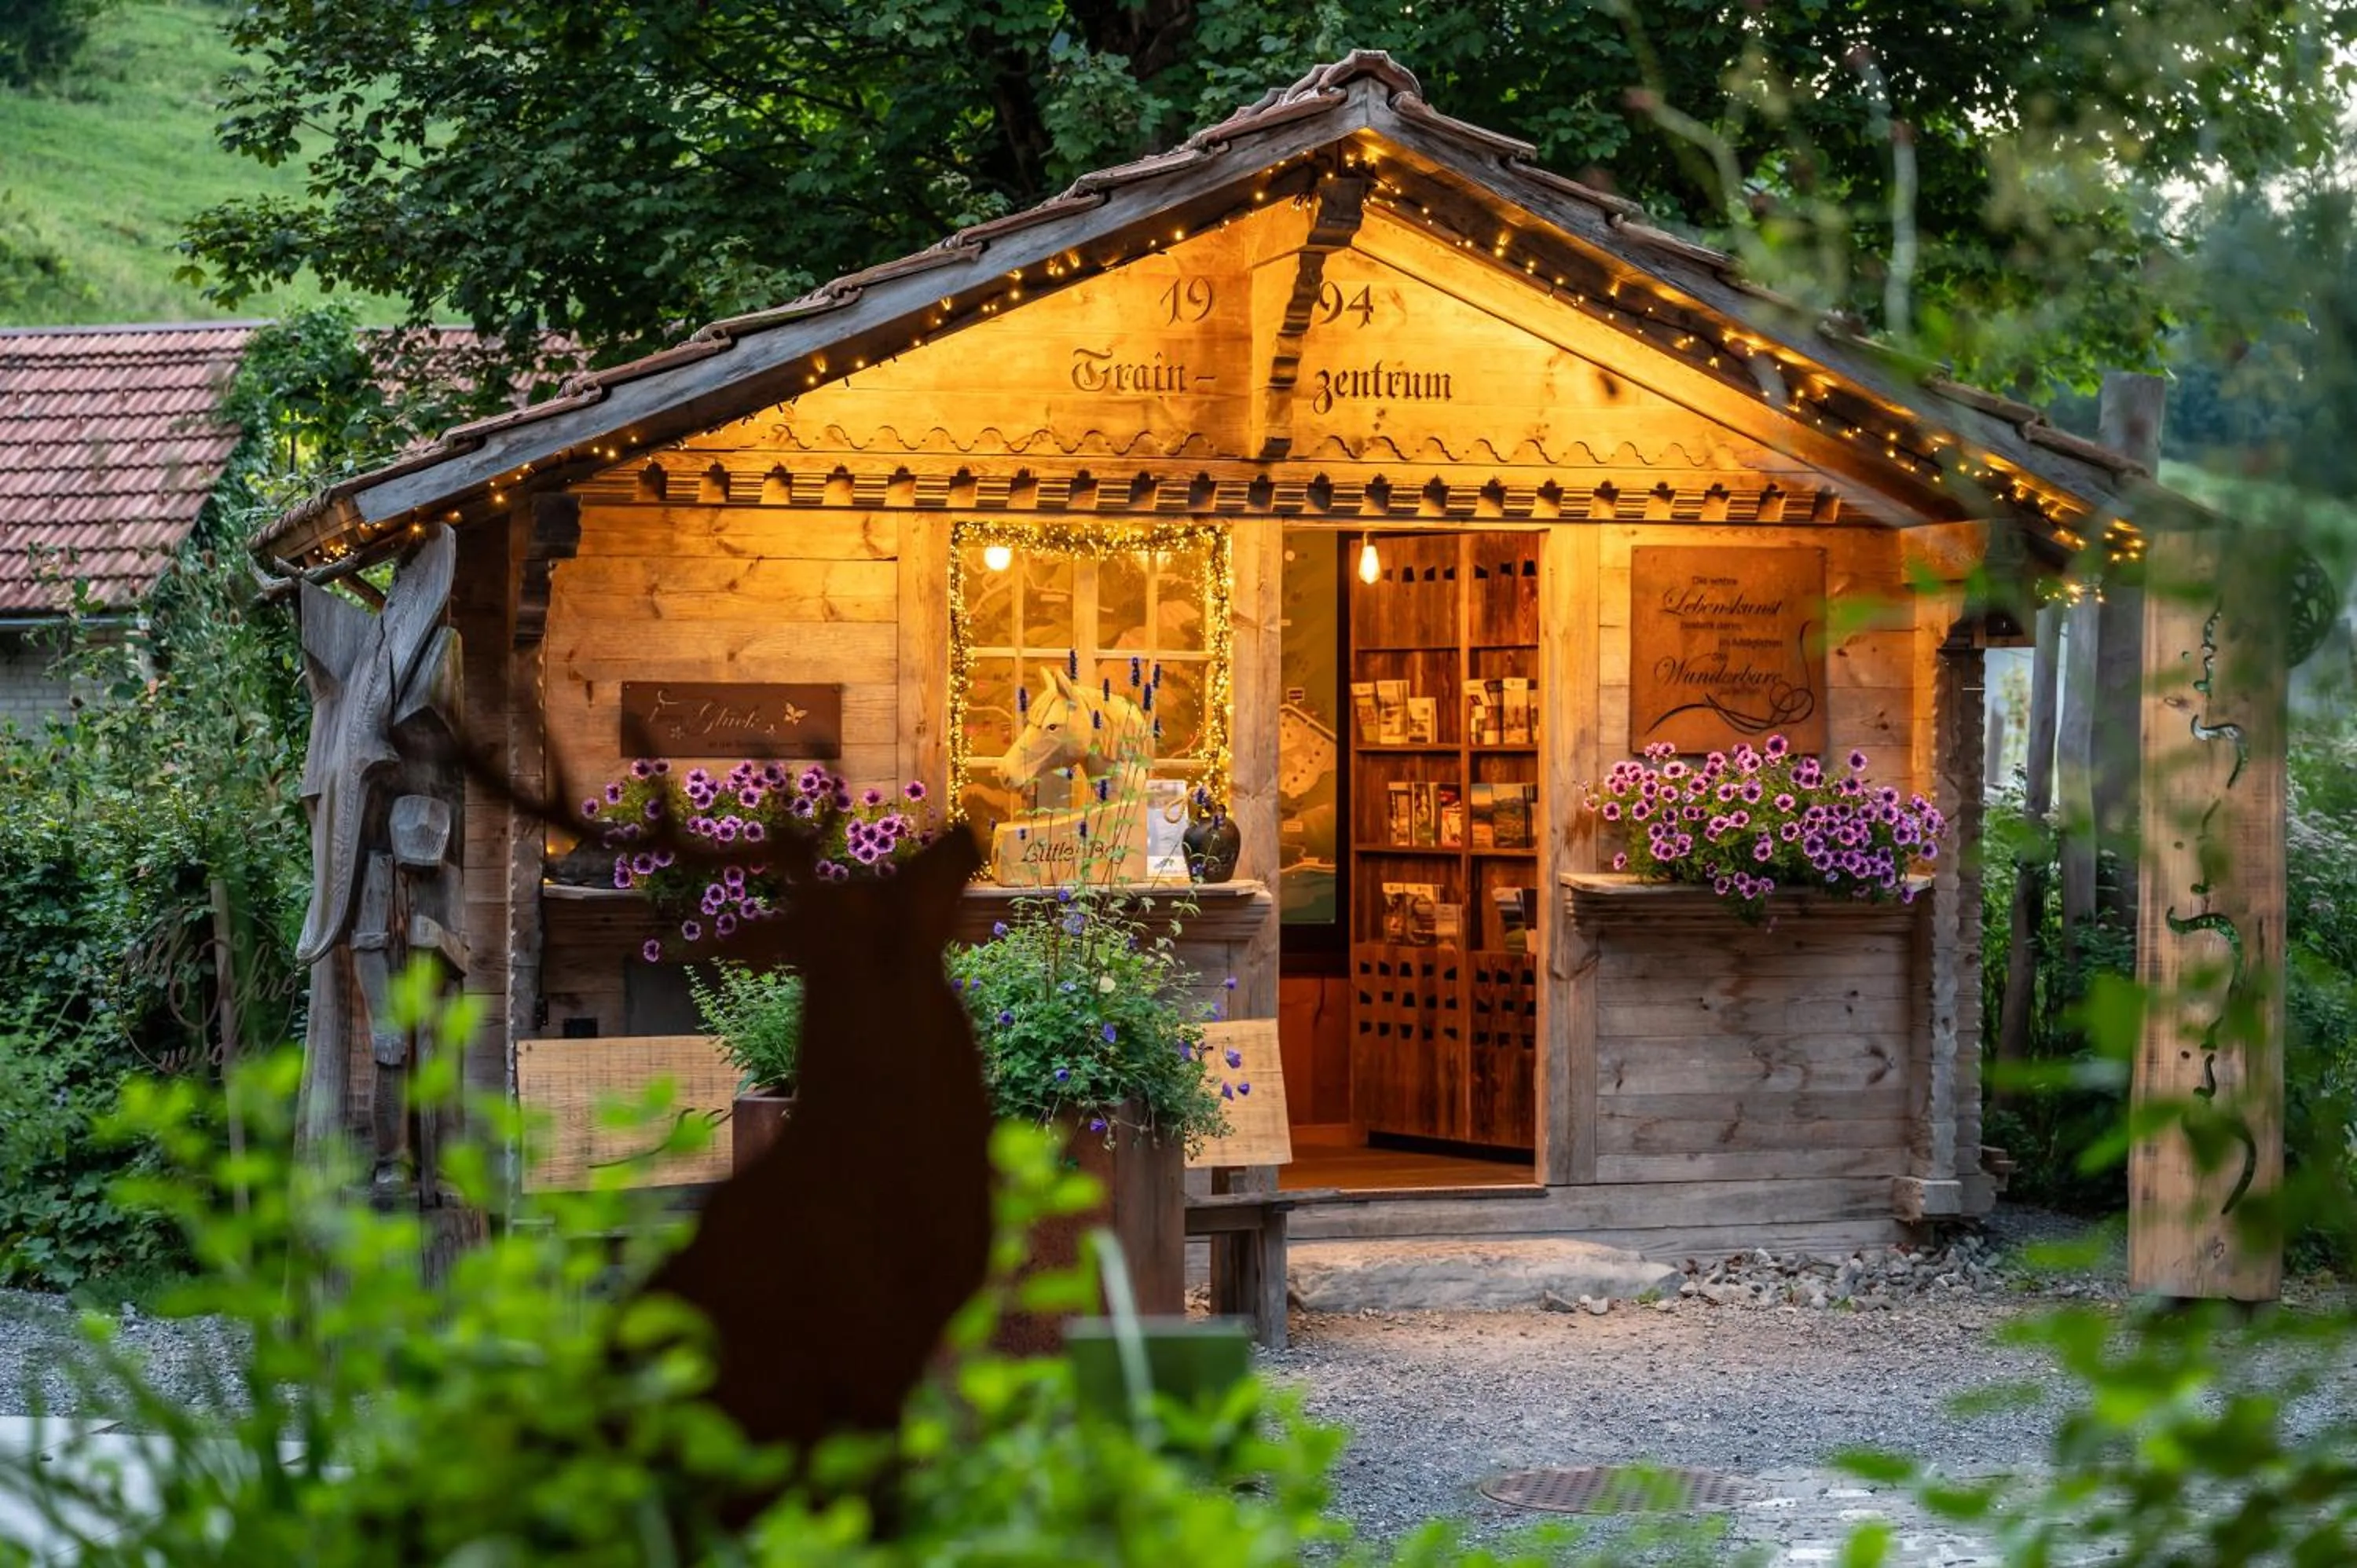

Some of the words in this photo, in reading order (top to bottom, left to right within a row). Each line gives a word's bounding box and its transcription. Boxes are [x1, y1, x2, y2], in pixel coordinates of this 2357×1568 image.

[1160, 277, 1213, 327] 19
[1318, 280, 1374, 329] 94
[1313, 360, 1453, 416] zentrum
